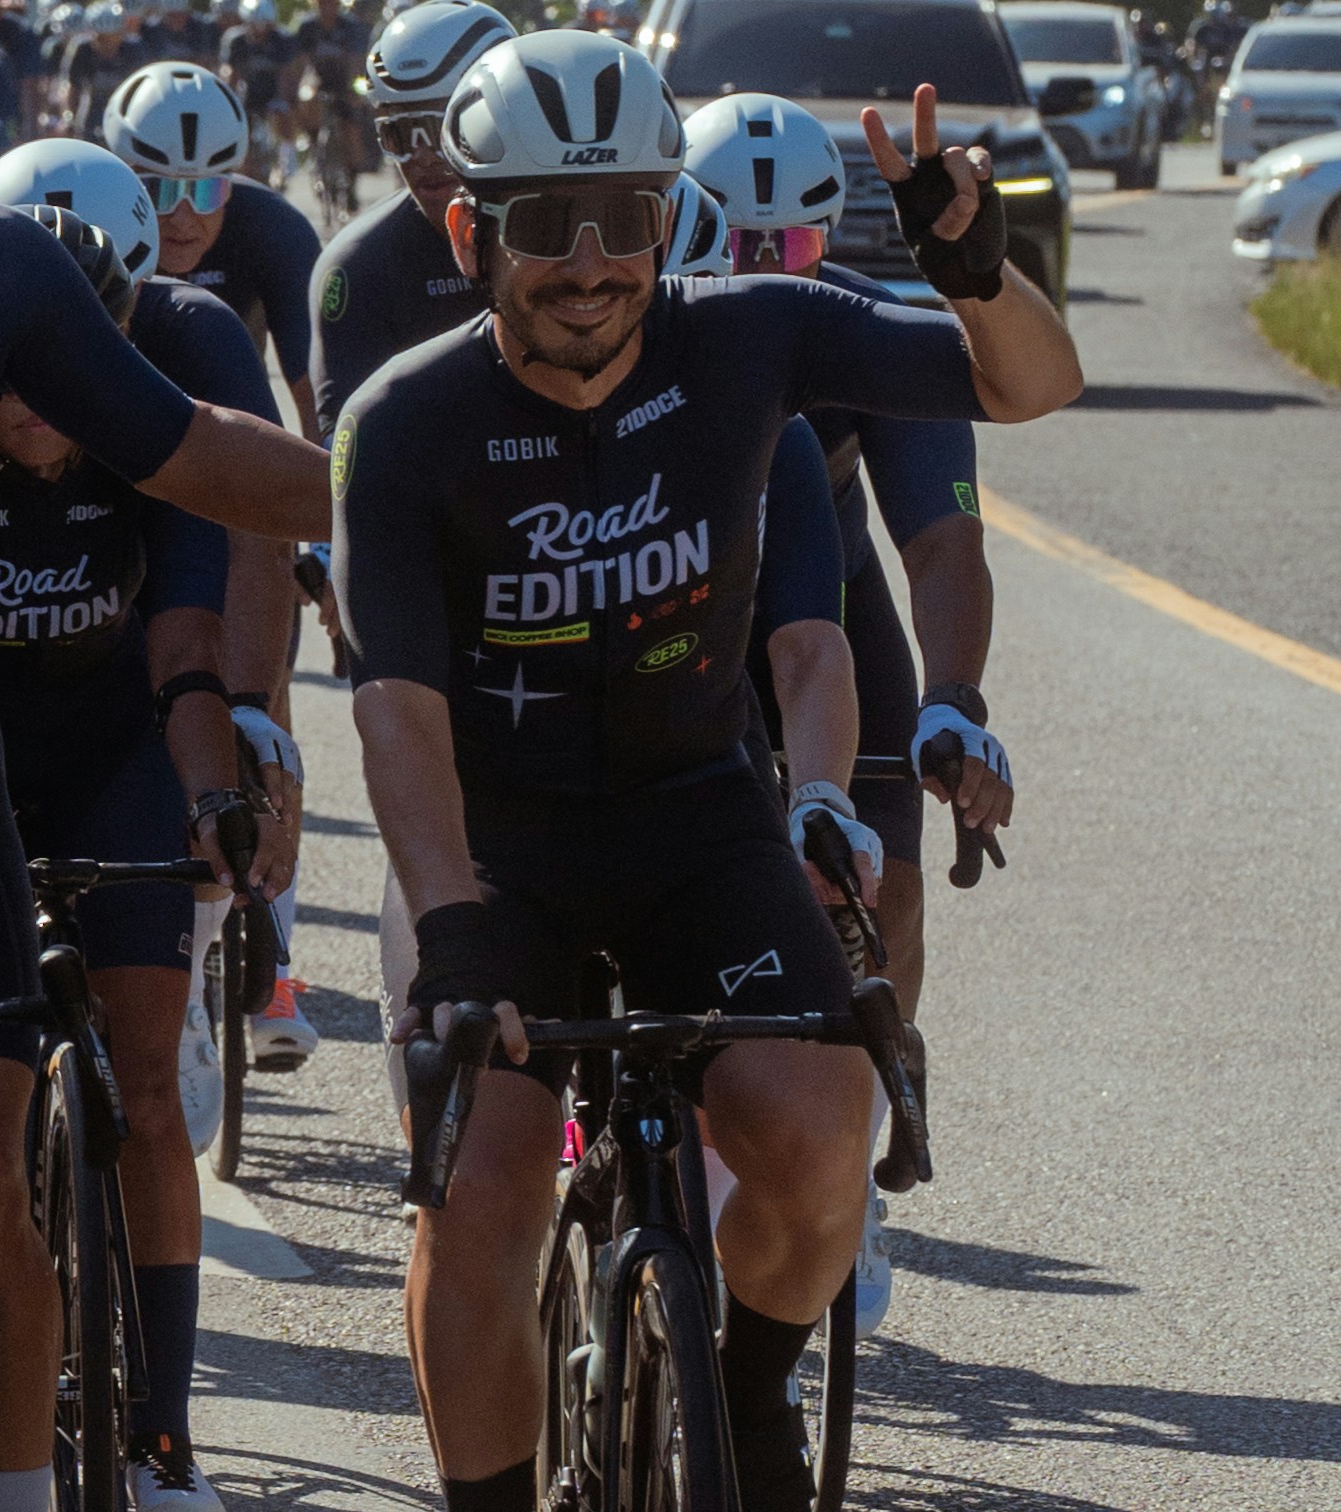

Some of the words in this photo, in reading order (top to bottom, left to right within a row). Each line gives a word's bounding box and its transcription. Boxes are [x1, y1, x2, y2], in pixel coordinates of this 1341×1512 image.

[561, 147, 617, 165] LAZER
[486, 436, 560, 463] GOBIK
[616, 384, 688, 439] 21DOCE
[507, 472, 671, 561] Road
[483, 518, 710, 623] EDITION
[645, 637, 689, 667] RE25
